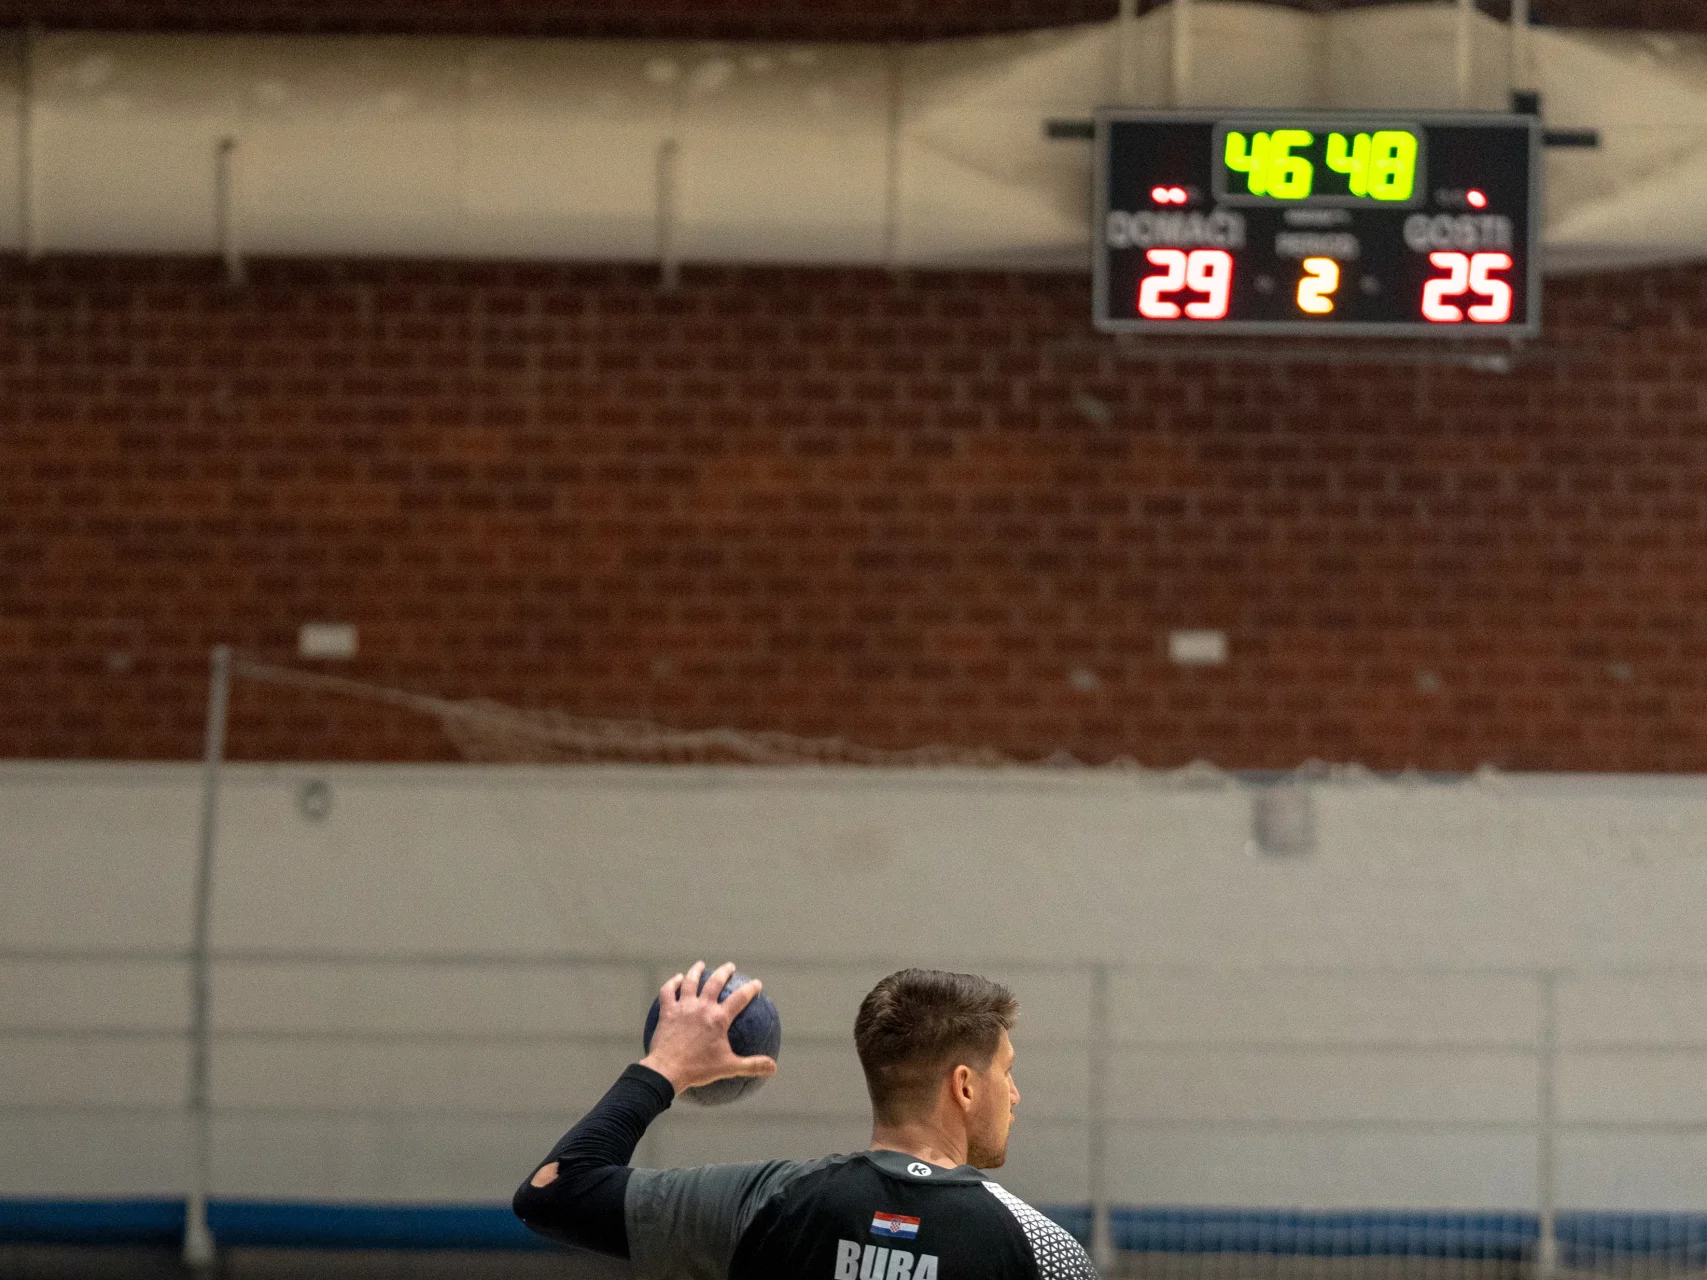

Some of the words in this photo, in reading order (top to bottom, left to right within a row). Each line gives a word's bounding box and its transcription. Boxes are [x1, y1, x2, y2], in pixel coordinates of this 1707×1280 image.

[1224, 130, 1313, 199] 46
[1326, 131, 1418, 200] 48
[1138, 248, 1233, 319] 29
[1297, 257, 1339, 313] 2
[1421, 252, 1513, 321] 25
